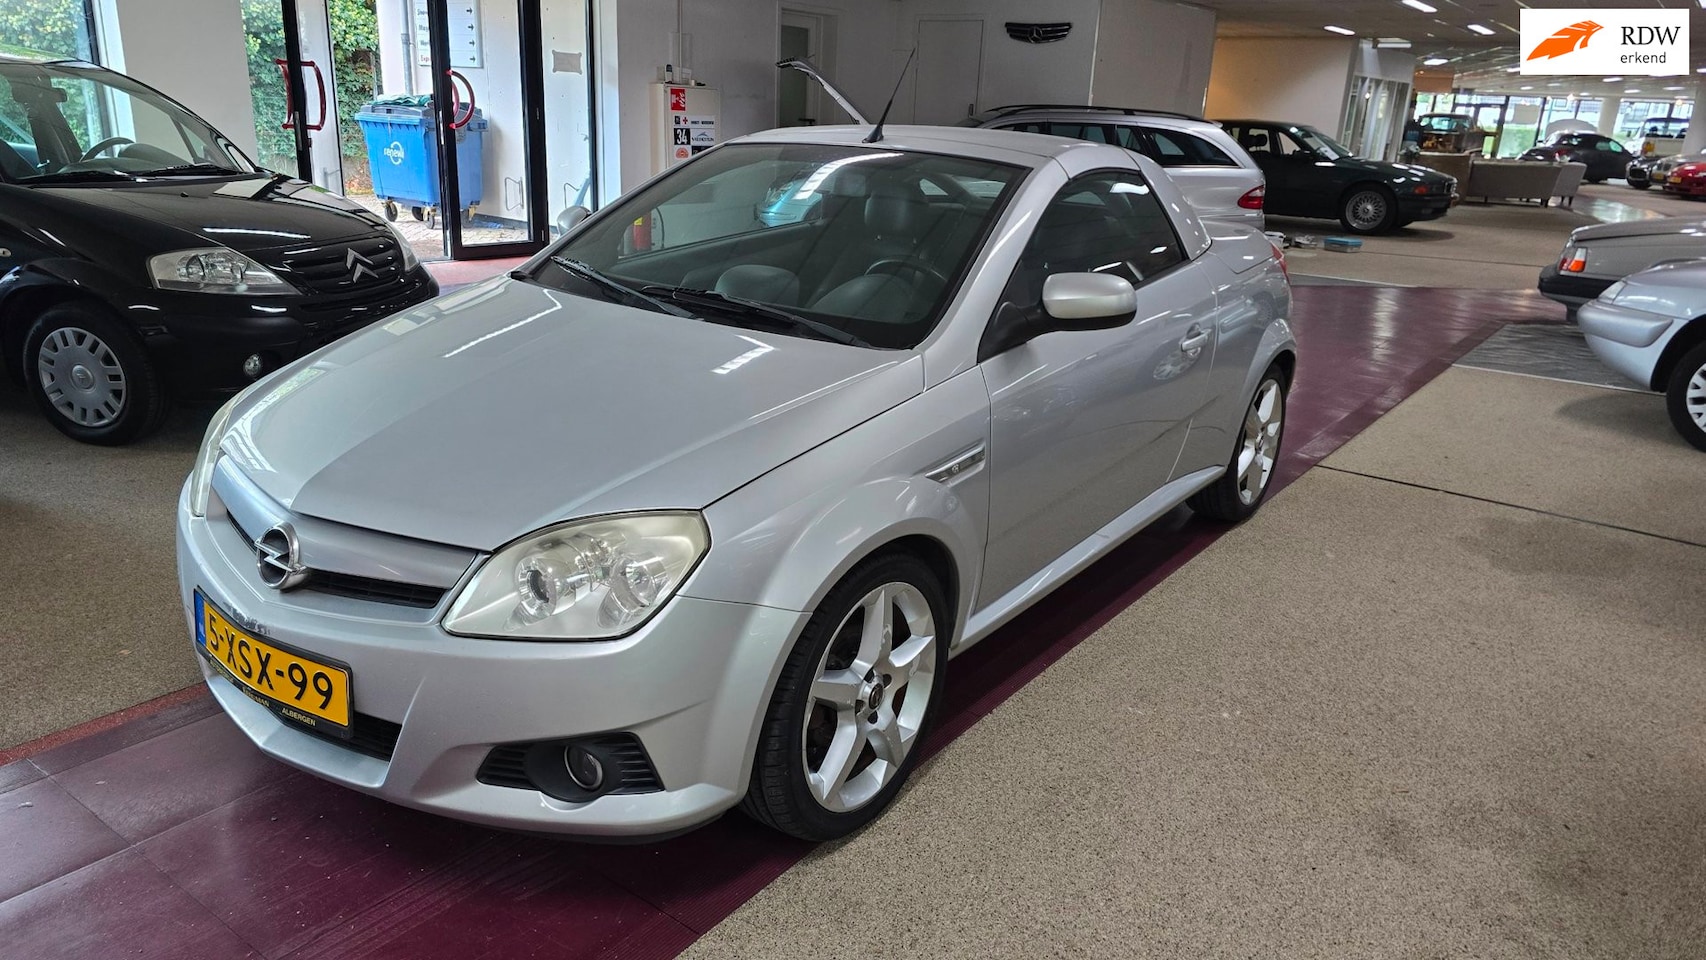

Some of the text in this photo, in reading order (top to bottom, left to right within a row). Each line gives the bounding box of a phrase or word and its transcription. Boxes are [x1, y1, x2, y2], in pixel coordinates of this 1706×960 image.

[676, 129, 688, 145] 34
[208, 612, 333, 710] 5-XSX-99
[281, 707, 317, 727] ALBERGEN
